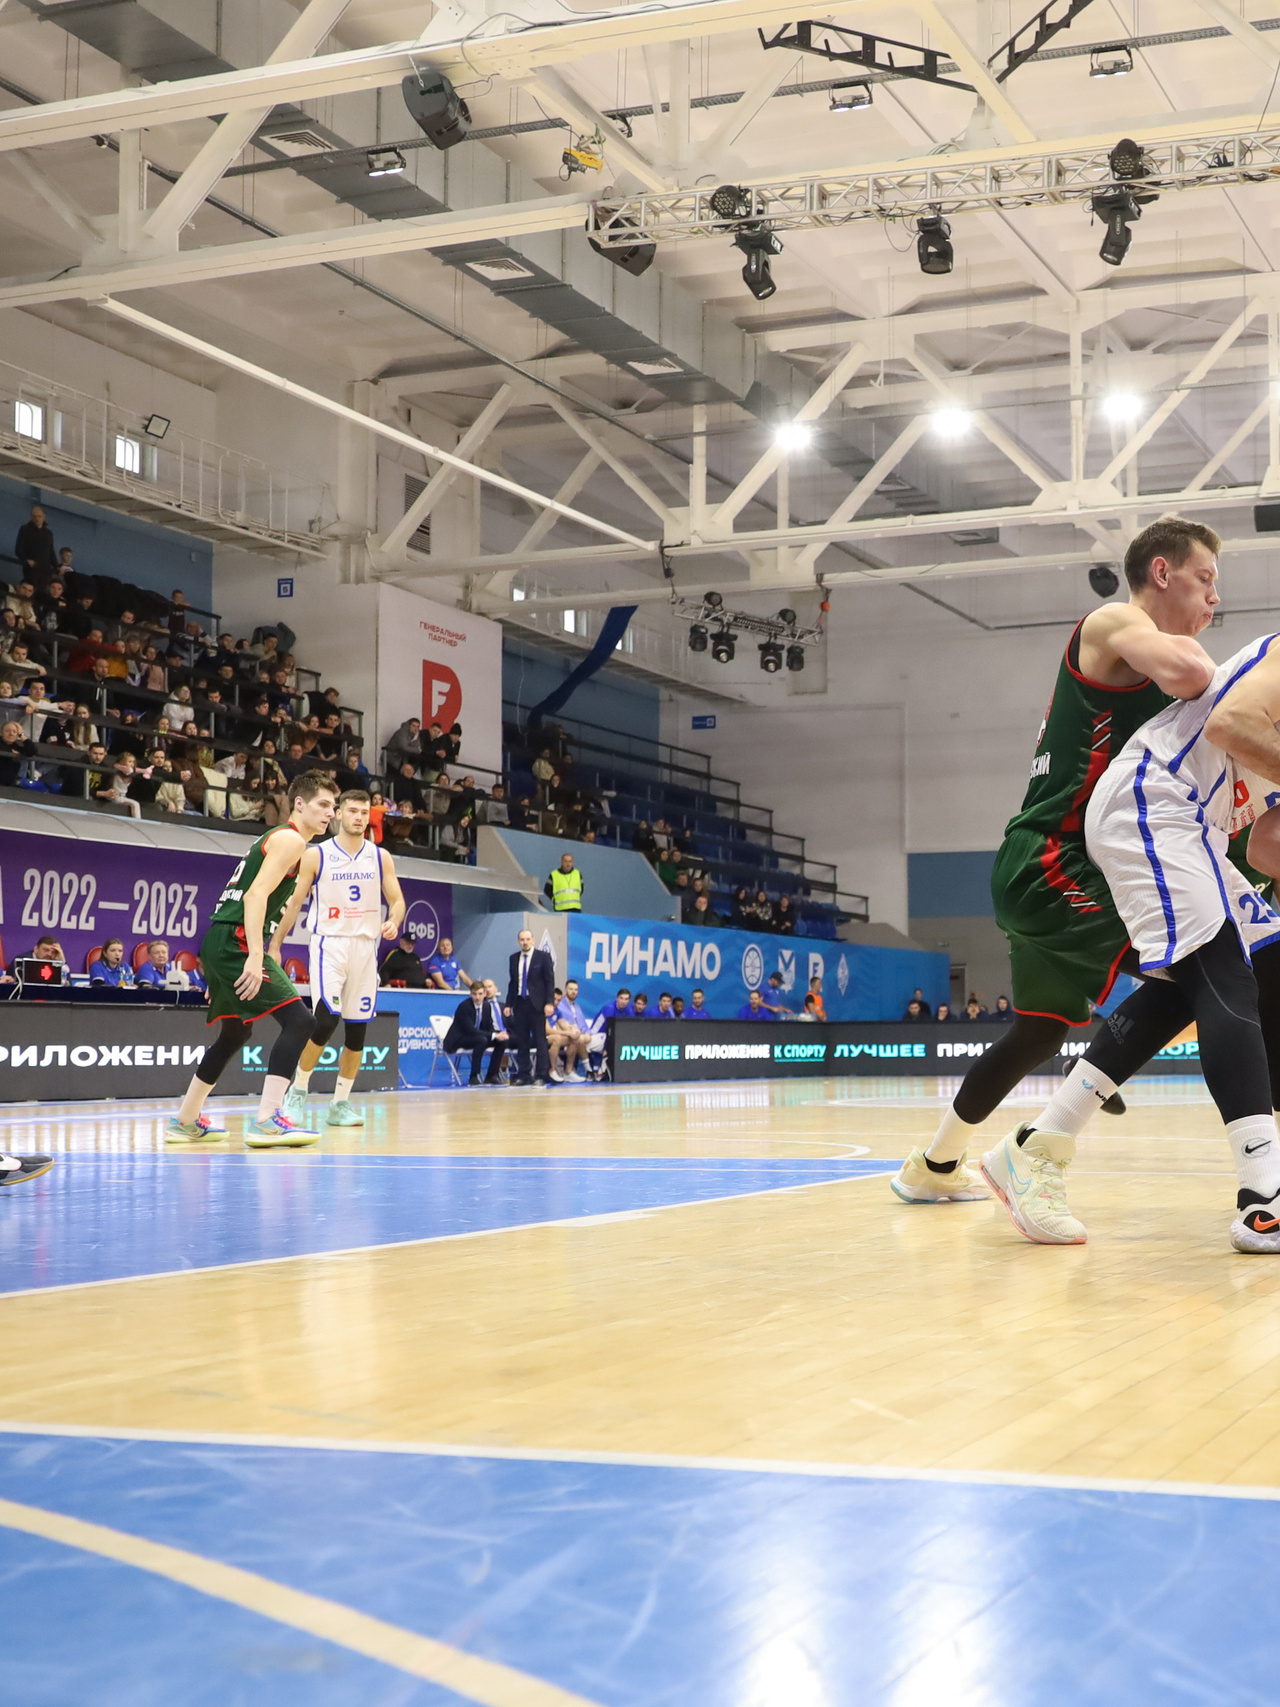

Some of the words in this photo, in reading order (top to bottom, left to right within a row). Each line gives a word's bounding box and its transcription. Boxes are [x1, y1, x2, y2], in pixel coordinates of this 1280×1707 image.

[420, 621, 467, 643] ГЕНЕРАЛЬНЫЙ
[428, 633, 458, 648] ПАРТНЕР
[349, 885, 361, 901] 3
[408, 921, 435, 940] РФБ
[586, 932, 721, 981] ДИНАМО
[359, 996, 372, 1013] 3
[1107, 1017, 1125, 1045] adidas
[0, 1045, 211, 1067] ИЛОЖЕНИ
[242, 1046, 263, 1065] К
[620, 1045, 680, 1061] ЛУЧШЕЕ
[685, 1044, 771, 1060] ПРИЛОЖЕНИЕ
[774, 1045, 783, 1058] К
[784, 1044, 827, 1058] СПОРТУ
[834, 1044, 926, 1058] ЛУЧШЕЕ
